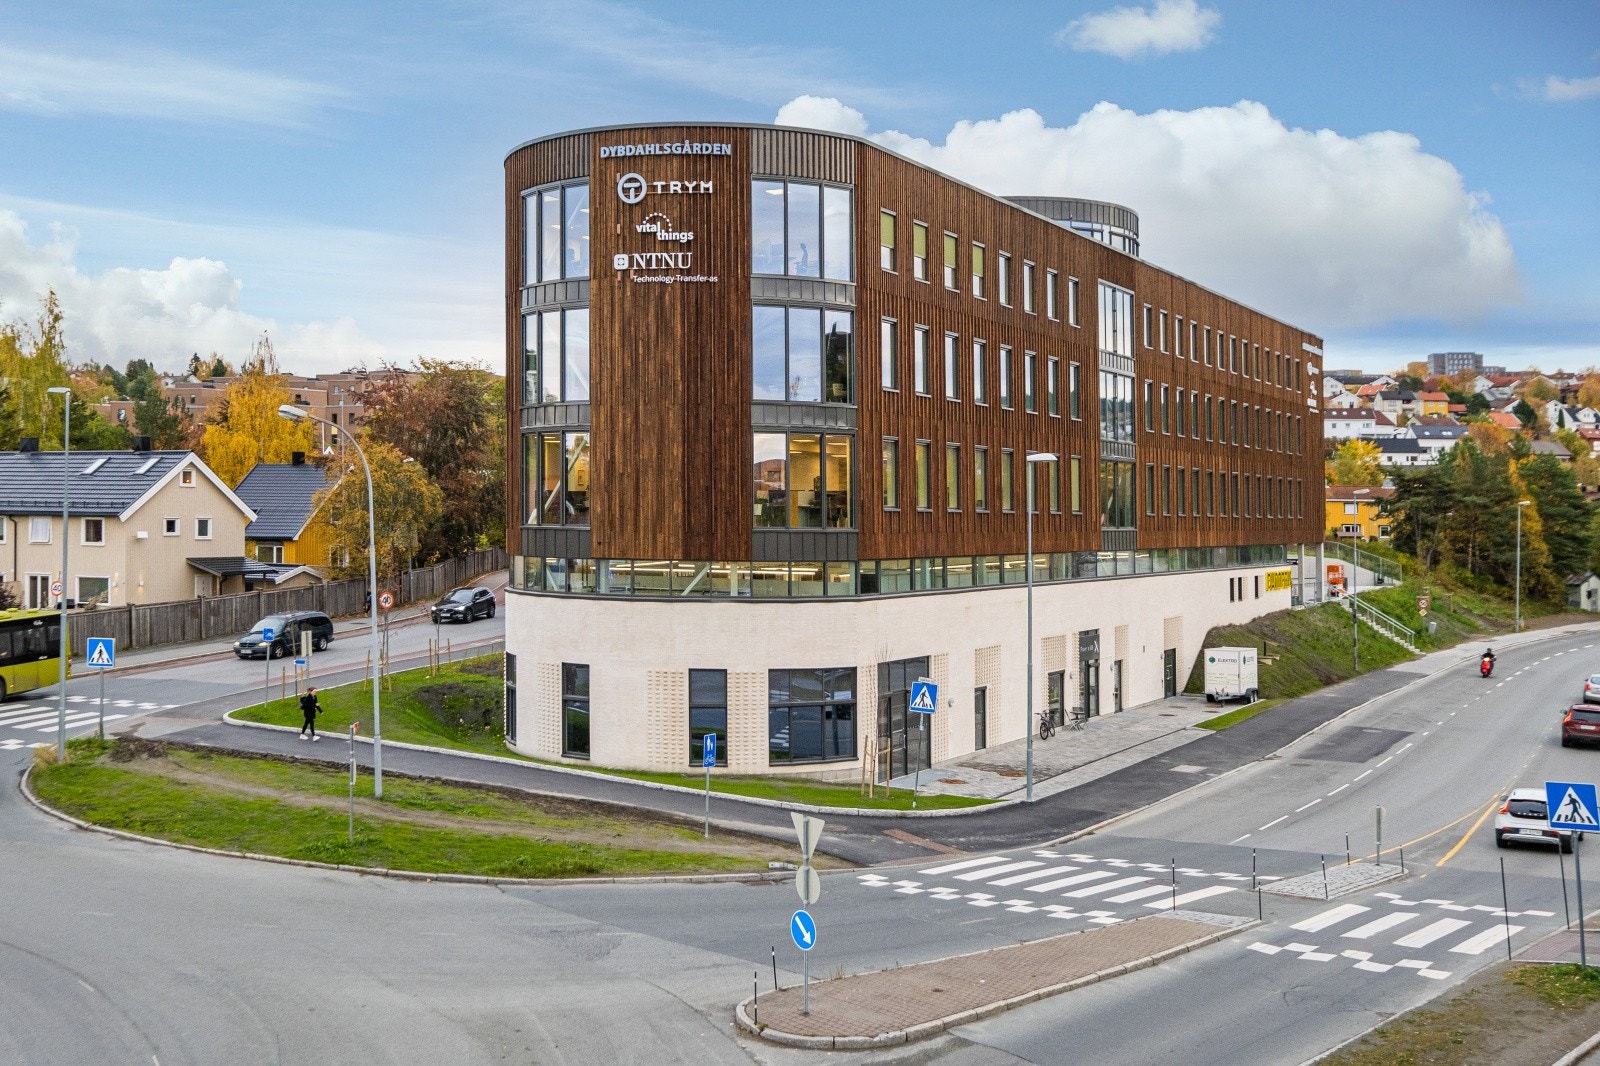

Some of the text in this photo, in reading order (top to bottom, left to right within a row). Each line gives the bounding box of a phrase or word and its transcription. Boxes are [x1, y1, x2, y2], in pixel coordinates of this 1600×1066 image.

[600, 140, 731, 158] DYBDAHLSGÅRDEN
[653, 181, 713, 194] TRYM
[636, 222, 661, 233] vital
[657, 230, 694, 243] things
[632, 253, 692, 269] NTNU
